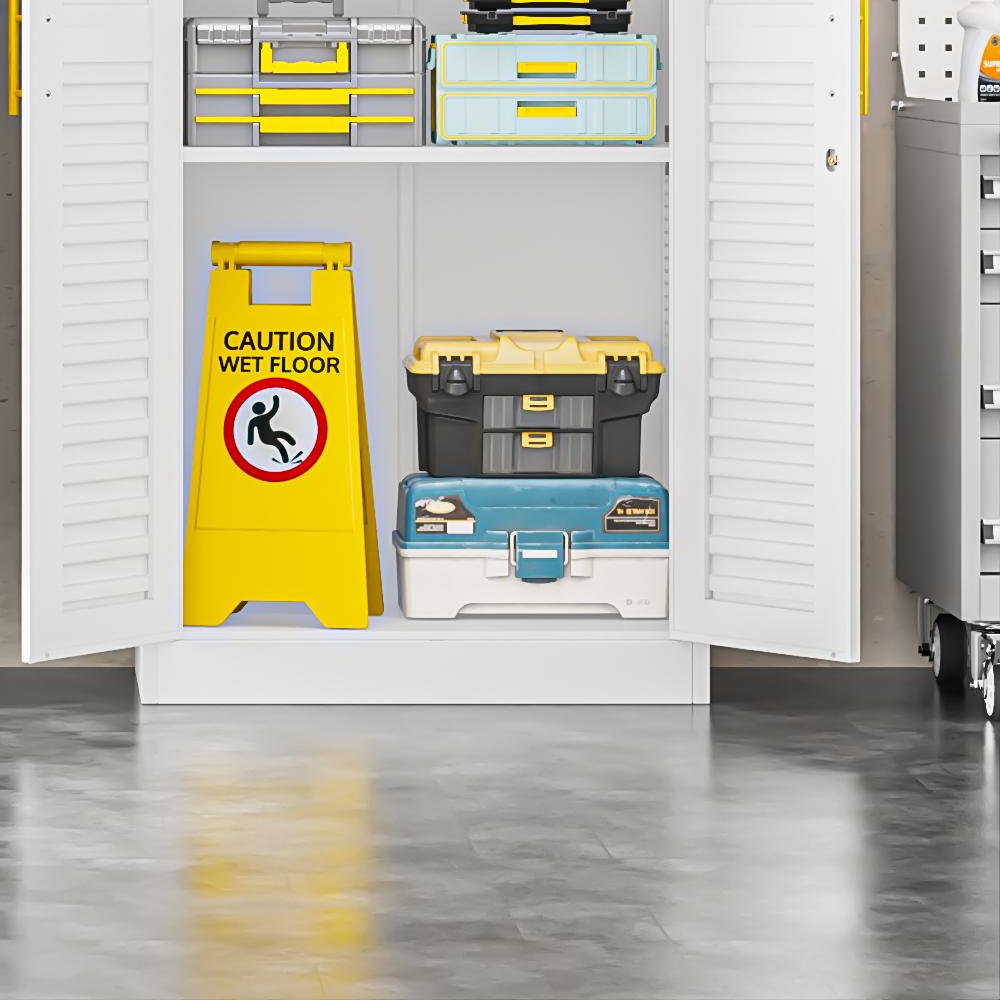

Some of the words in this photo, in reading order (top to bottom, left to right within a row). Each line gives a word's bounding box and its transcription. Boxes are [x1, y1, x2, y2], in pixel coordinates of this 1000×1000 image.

[223, 330, 335, 352] CAUTION
[218, 356, 265, 374] WET
[270, 356, 340, 374] FLOOR
